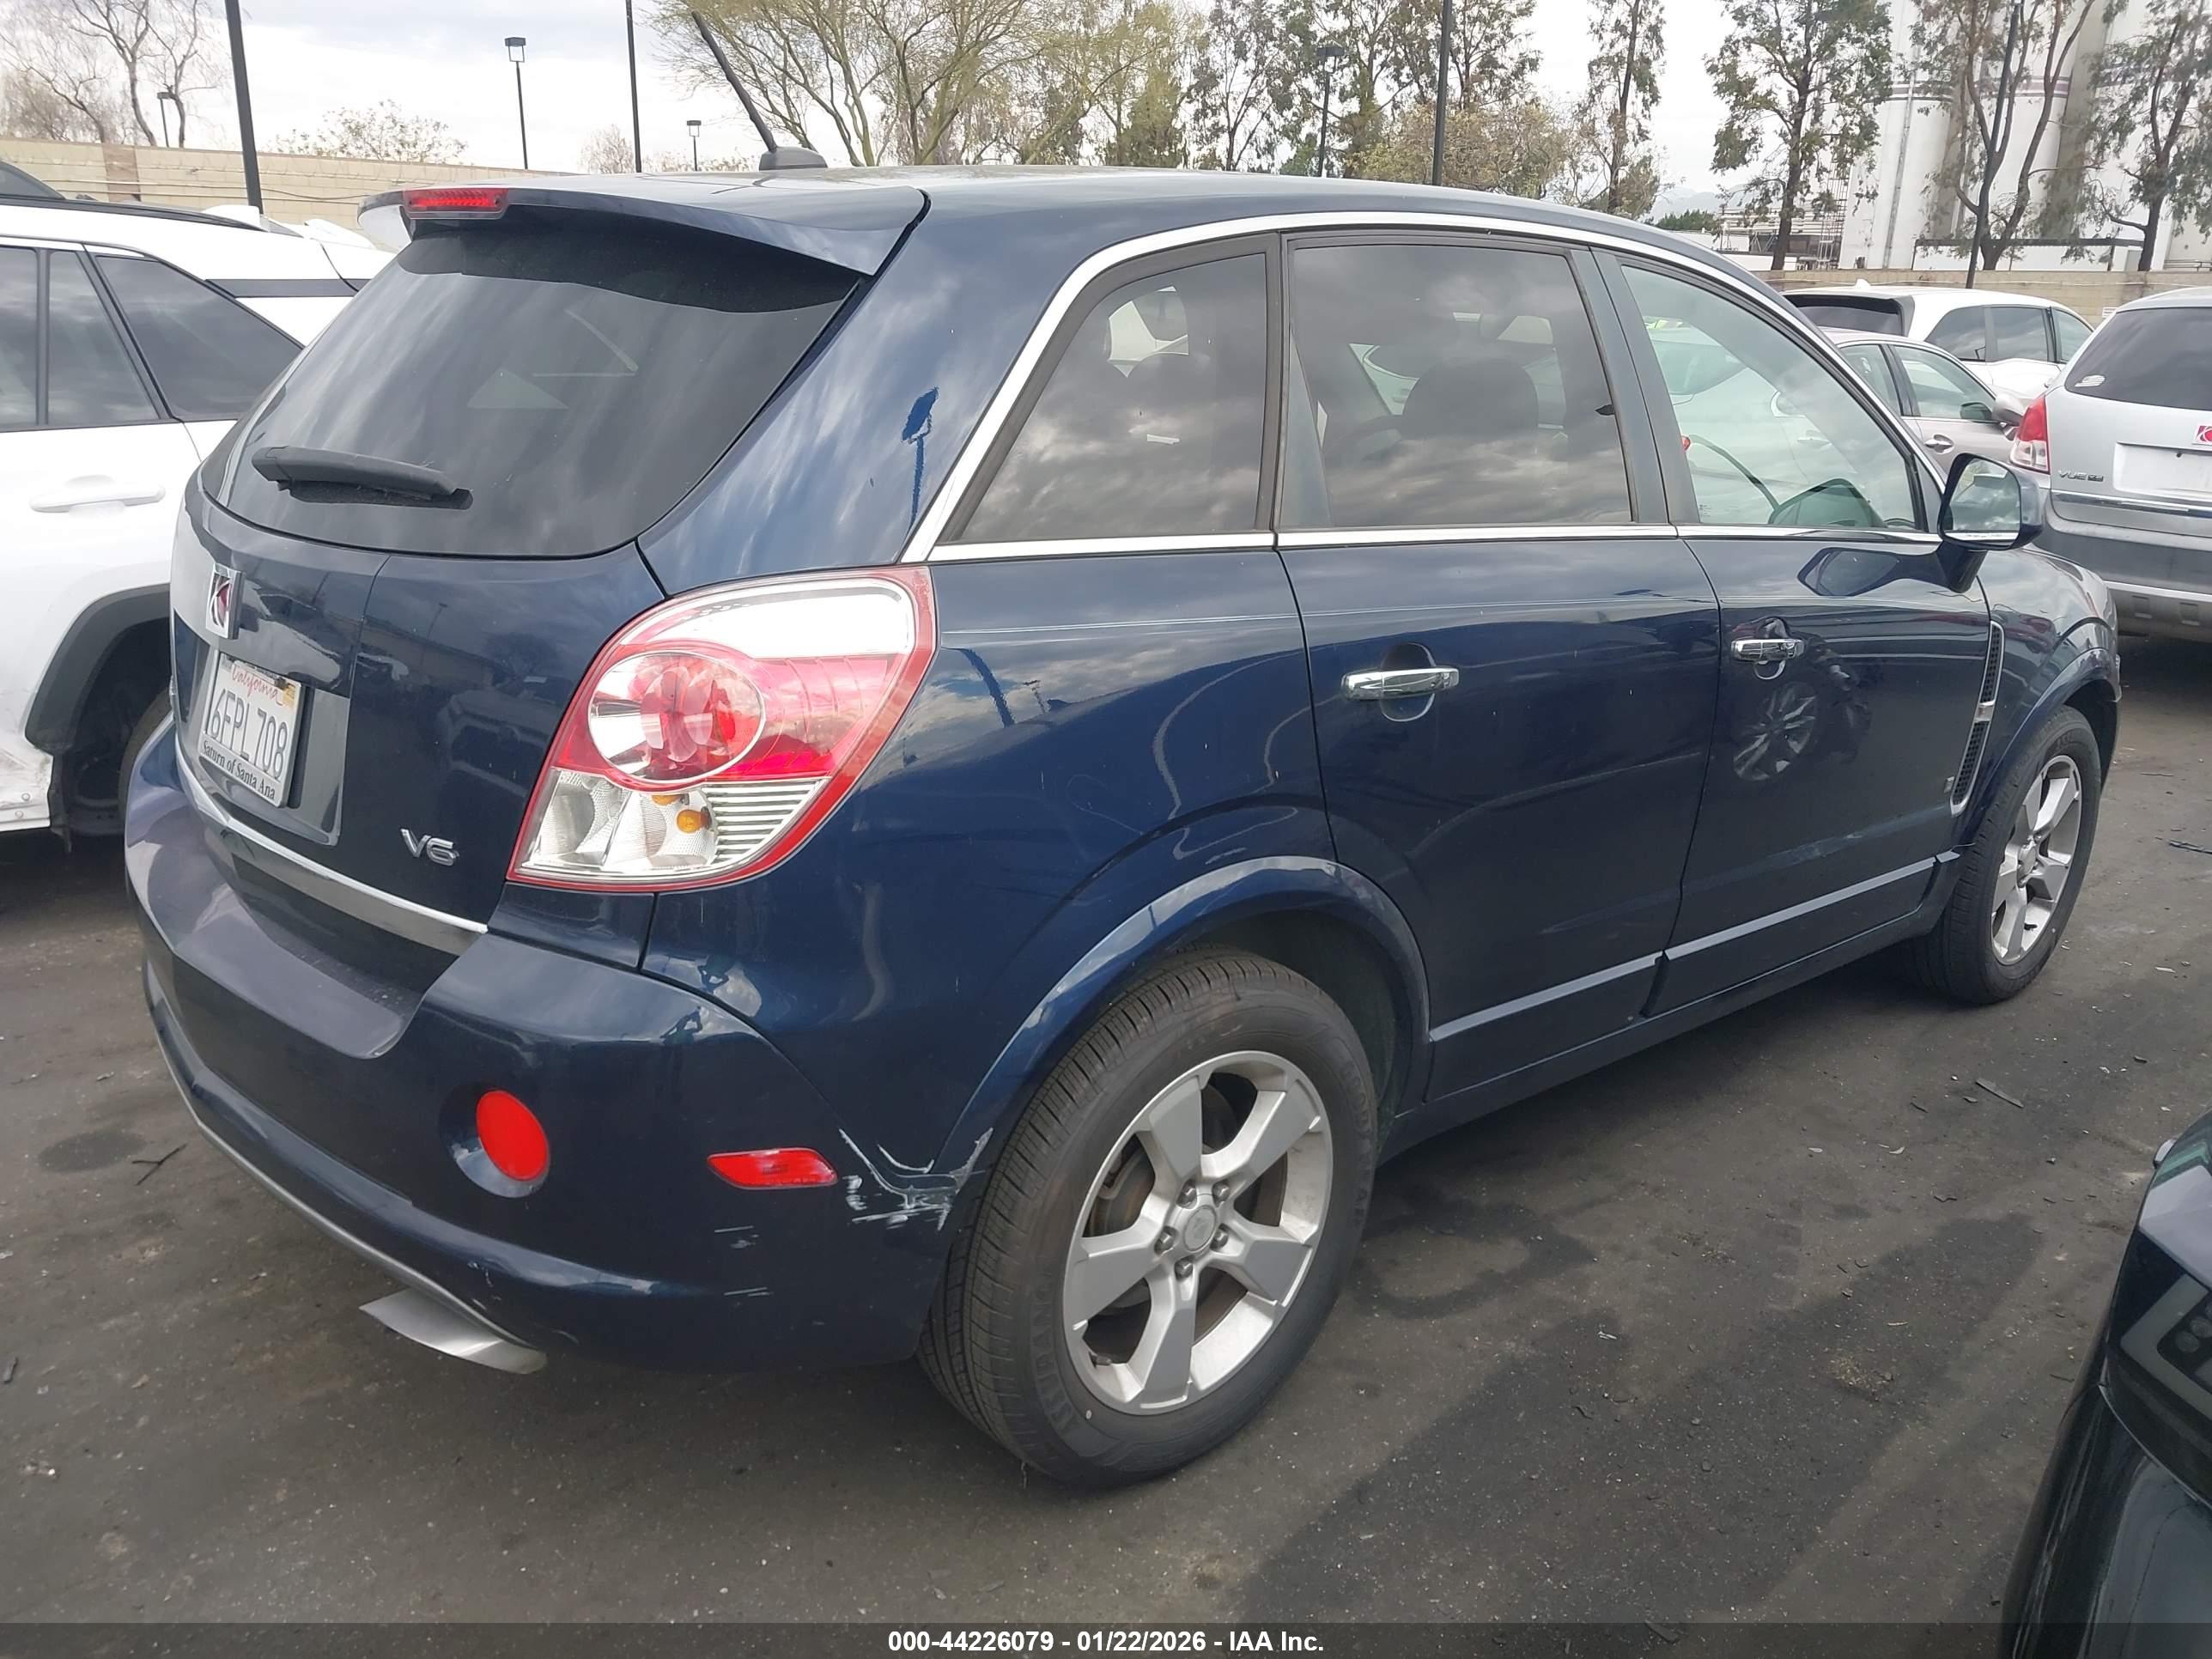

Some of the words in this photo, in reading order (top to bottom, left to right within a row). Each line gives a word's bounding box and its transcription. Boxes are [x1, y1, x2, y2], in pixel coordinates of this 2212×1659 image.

[2058, 471, 2087, 482] VUE
[232, 664, 283, 706] California
[203, 740, 225, 769] Saturn
[227, 757, 238, 774] of
[237, 763, 261, 789] Santa
[258, 776, 276, 800] Ana
[400, 829, 458, 866] V6
